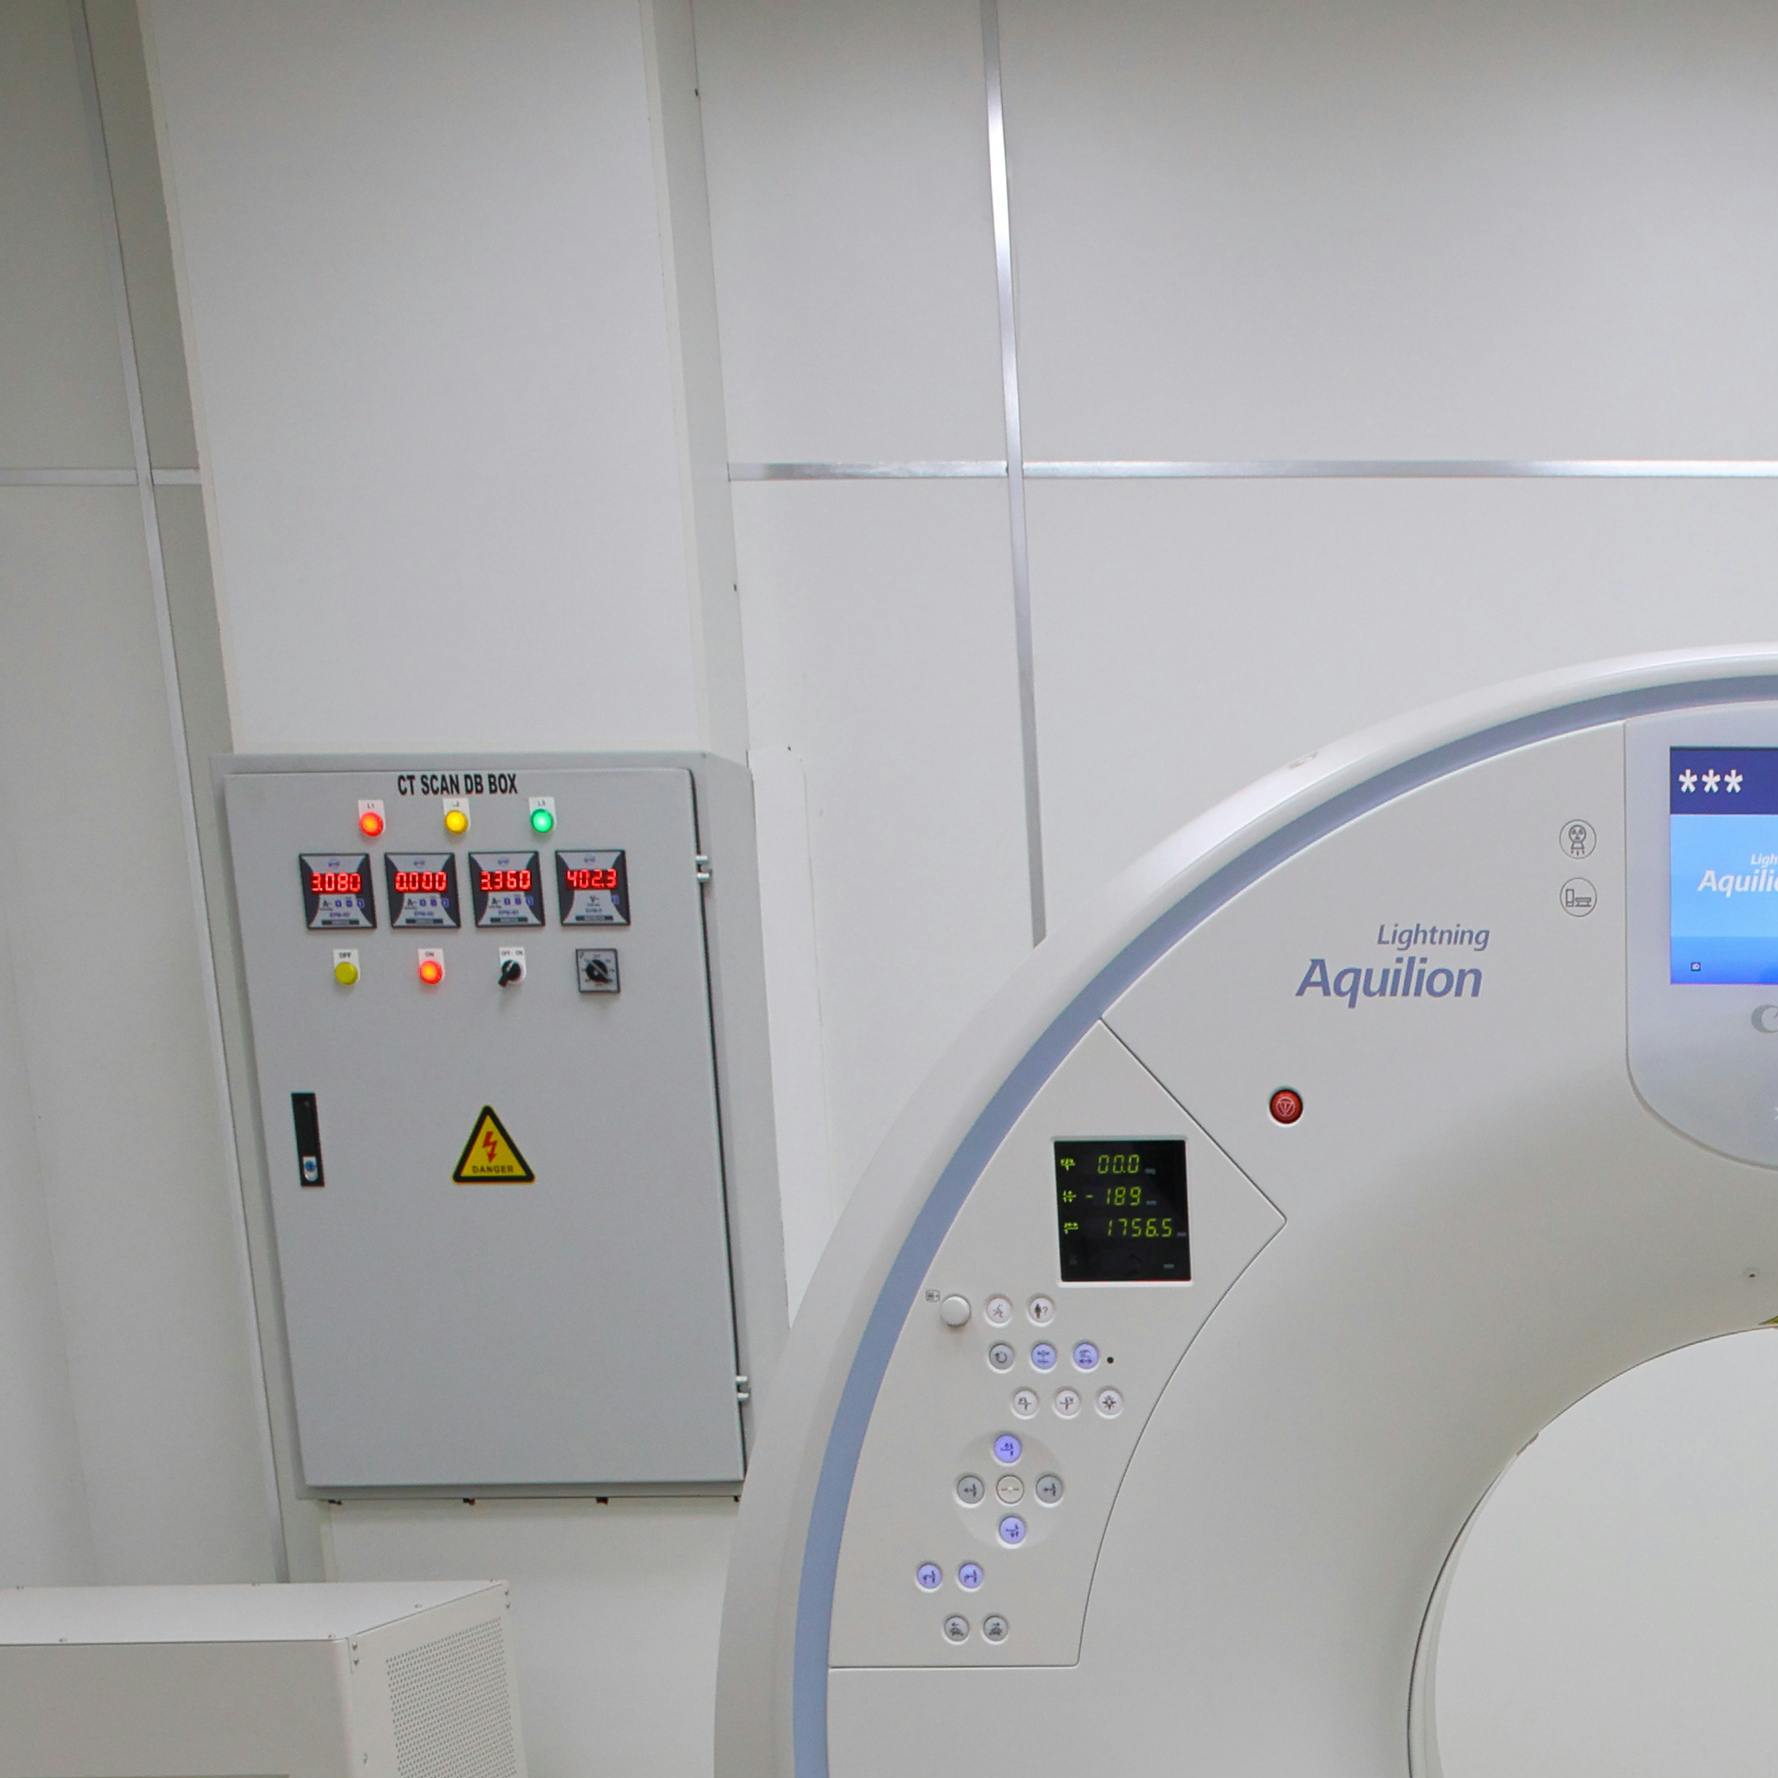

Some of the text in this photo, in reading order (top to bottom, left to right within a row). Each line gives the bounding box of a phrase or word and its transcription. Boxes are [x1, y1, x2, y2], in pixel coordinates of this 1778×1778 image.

[397, 773, 519, 795] CT SCAN DB BOX
[311, 872, 361, 892] 3.080
[567, 869, 617, 888] 402.3
[1376, 923, 1490, 951] Lightning
[1295, 956, 1483, 1009] Aquilion
[472, 1165, 514, 1173] DANGER
